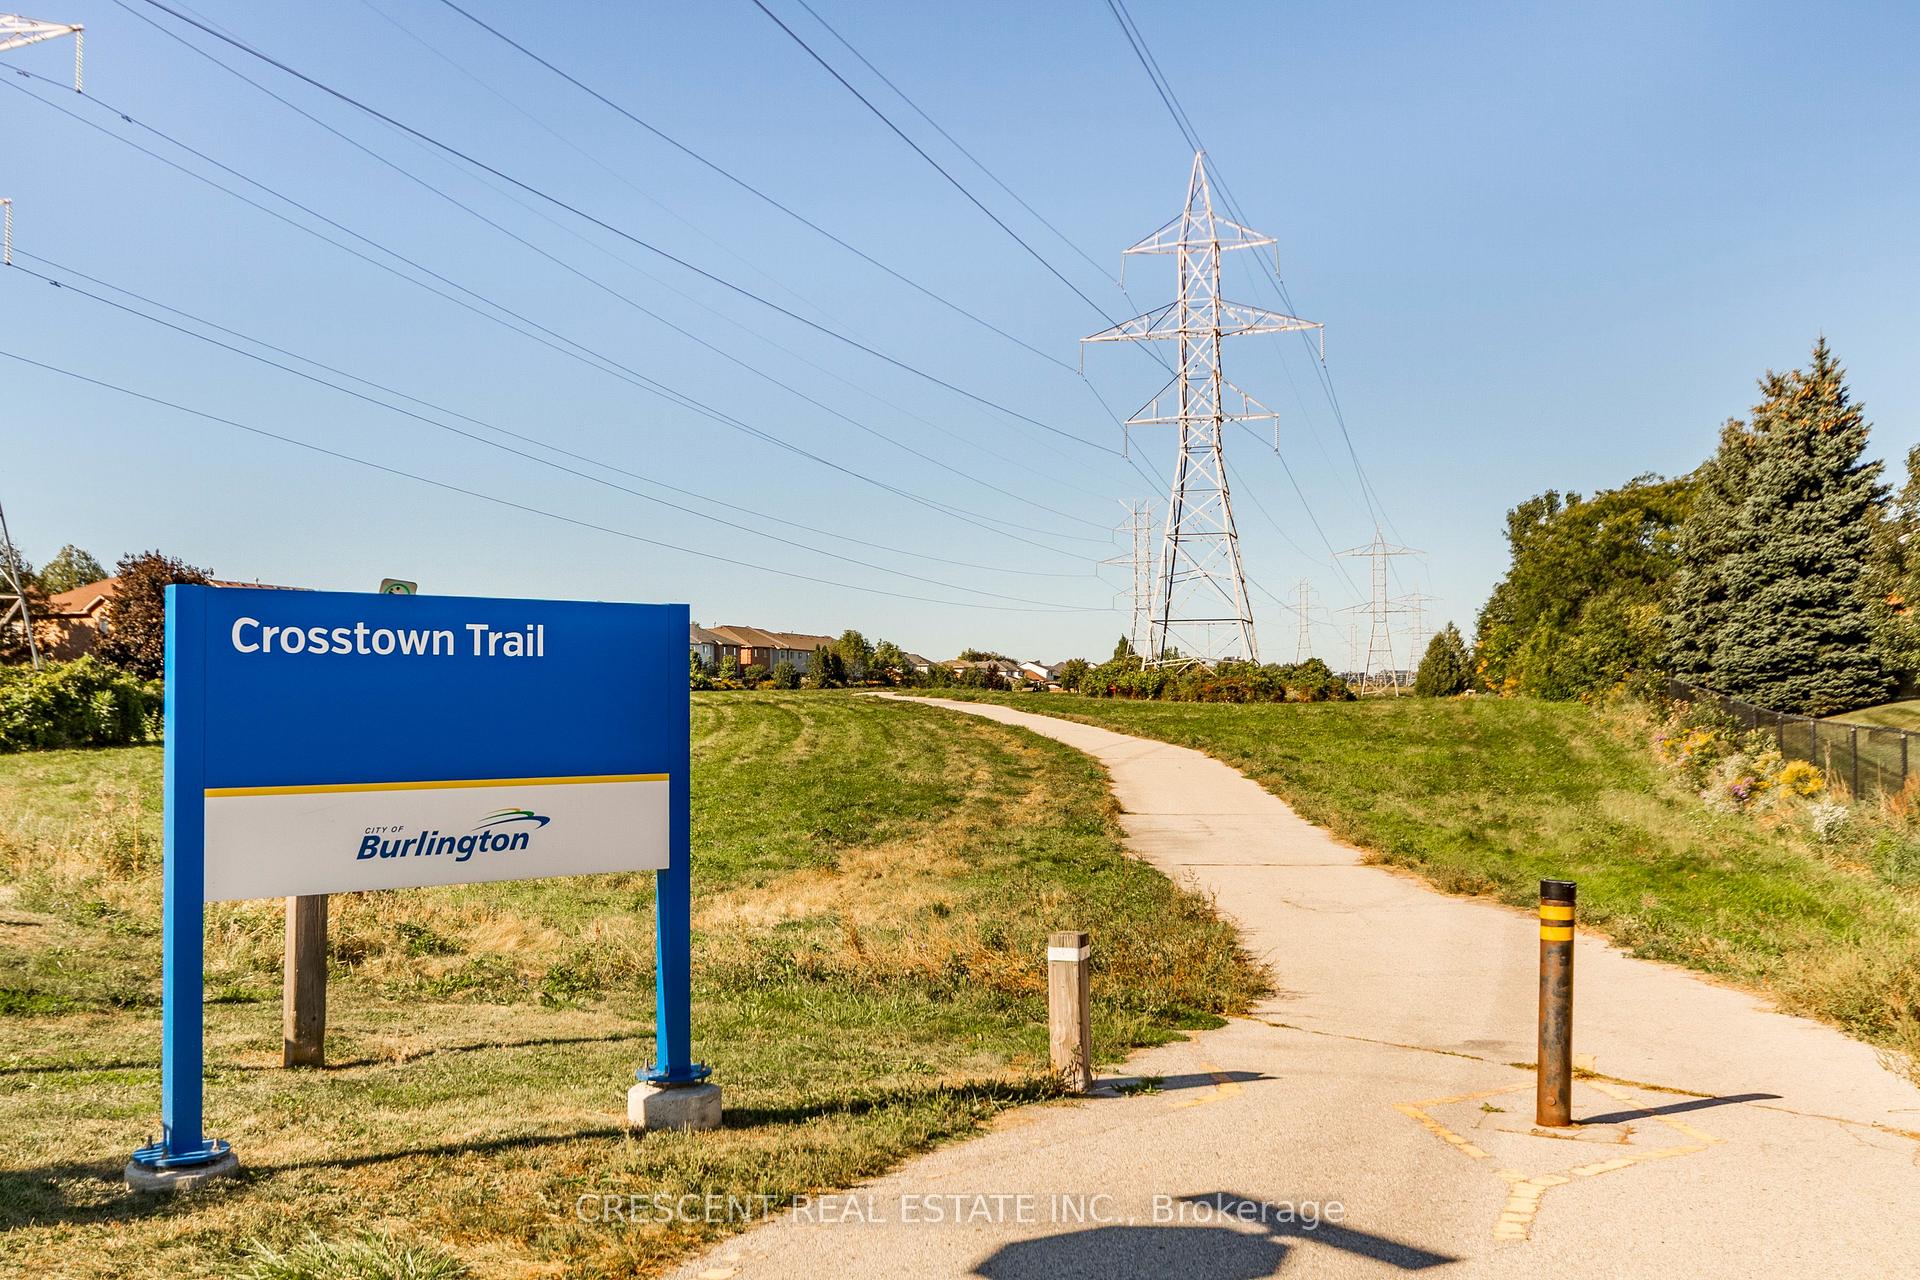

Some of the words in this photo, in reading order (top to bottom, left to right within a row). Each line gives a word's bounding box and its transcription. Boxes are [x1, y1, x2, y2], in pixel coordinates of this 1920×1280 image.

[231, 617, 454, 655] Crosstown
[465, 623, 544, 657] Trail
[364, 826, 387, 834] CITY
[391, 825, 404, 833] OF
[356, 830, 529, 862] Burlington
